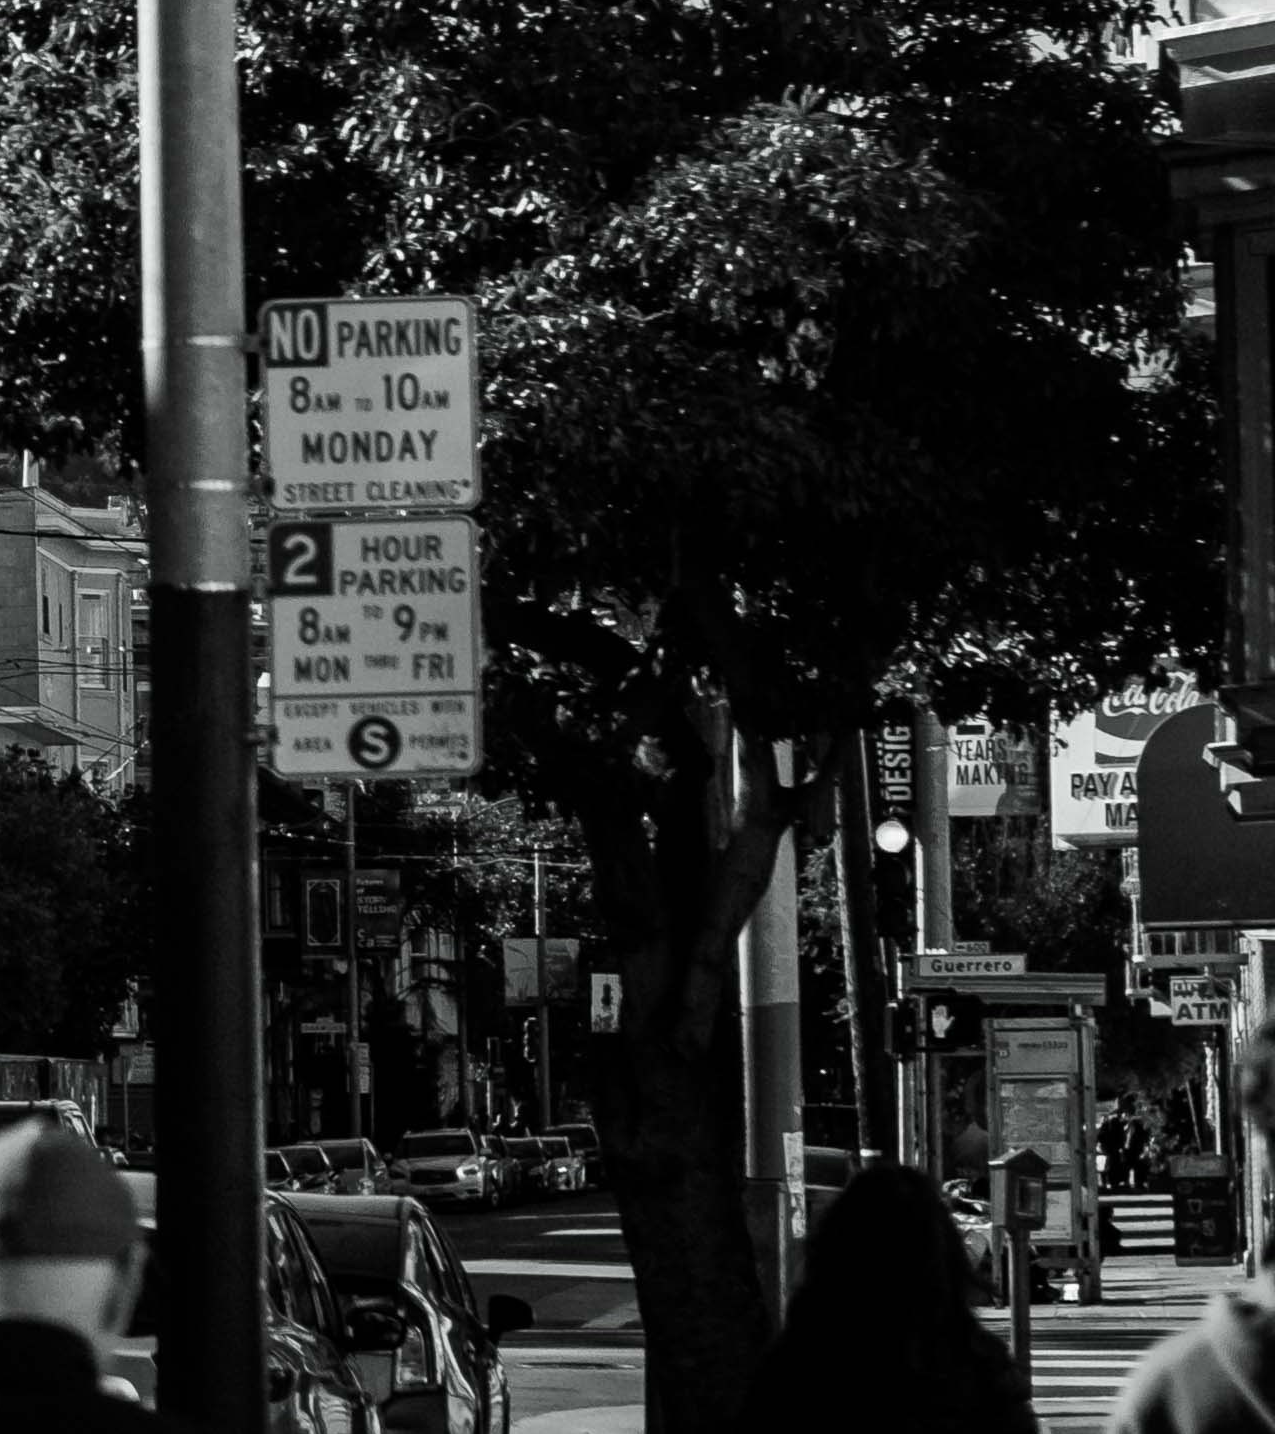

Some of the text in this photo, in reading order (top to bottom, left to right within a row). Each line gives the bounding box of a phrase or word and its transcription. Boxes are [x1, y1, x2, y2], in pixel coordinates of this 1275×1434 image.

[269, 309, 461, 361] NO PARKING
[290, 376, 342, 414] 8AM
[382, 372, 450, 412] 10AM
[302, 429, 438, 464] MONDAY
[283, 480, 461, 504] STREET CLEANING
[283, 533, 442, 583] 2 HOUR
[338, 566, 466, 596] PARKING
[298, 607, 350, 646] 8AM
[294, 655, 350, 682] MON
[412, 652, 454, 681] FRI
[360, 724, 390, 762] S
[955, 739, 1007, 761] YEARS
[882, 721, 912, 802] DESIG
[956, 763, 1028, 785] MAKING
[1071, 772, 1115, 799] PAY
[931, 958, 1013, 974] Guerrero
[1176, 1002, 1229, 1021] ATM
